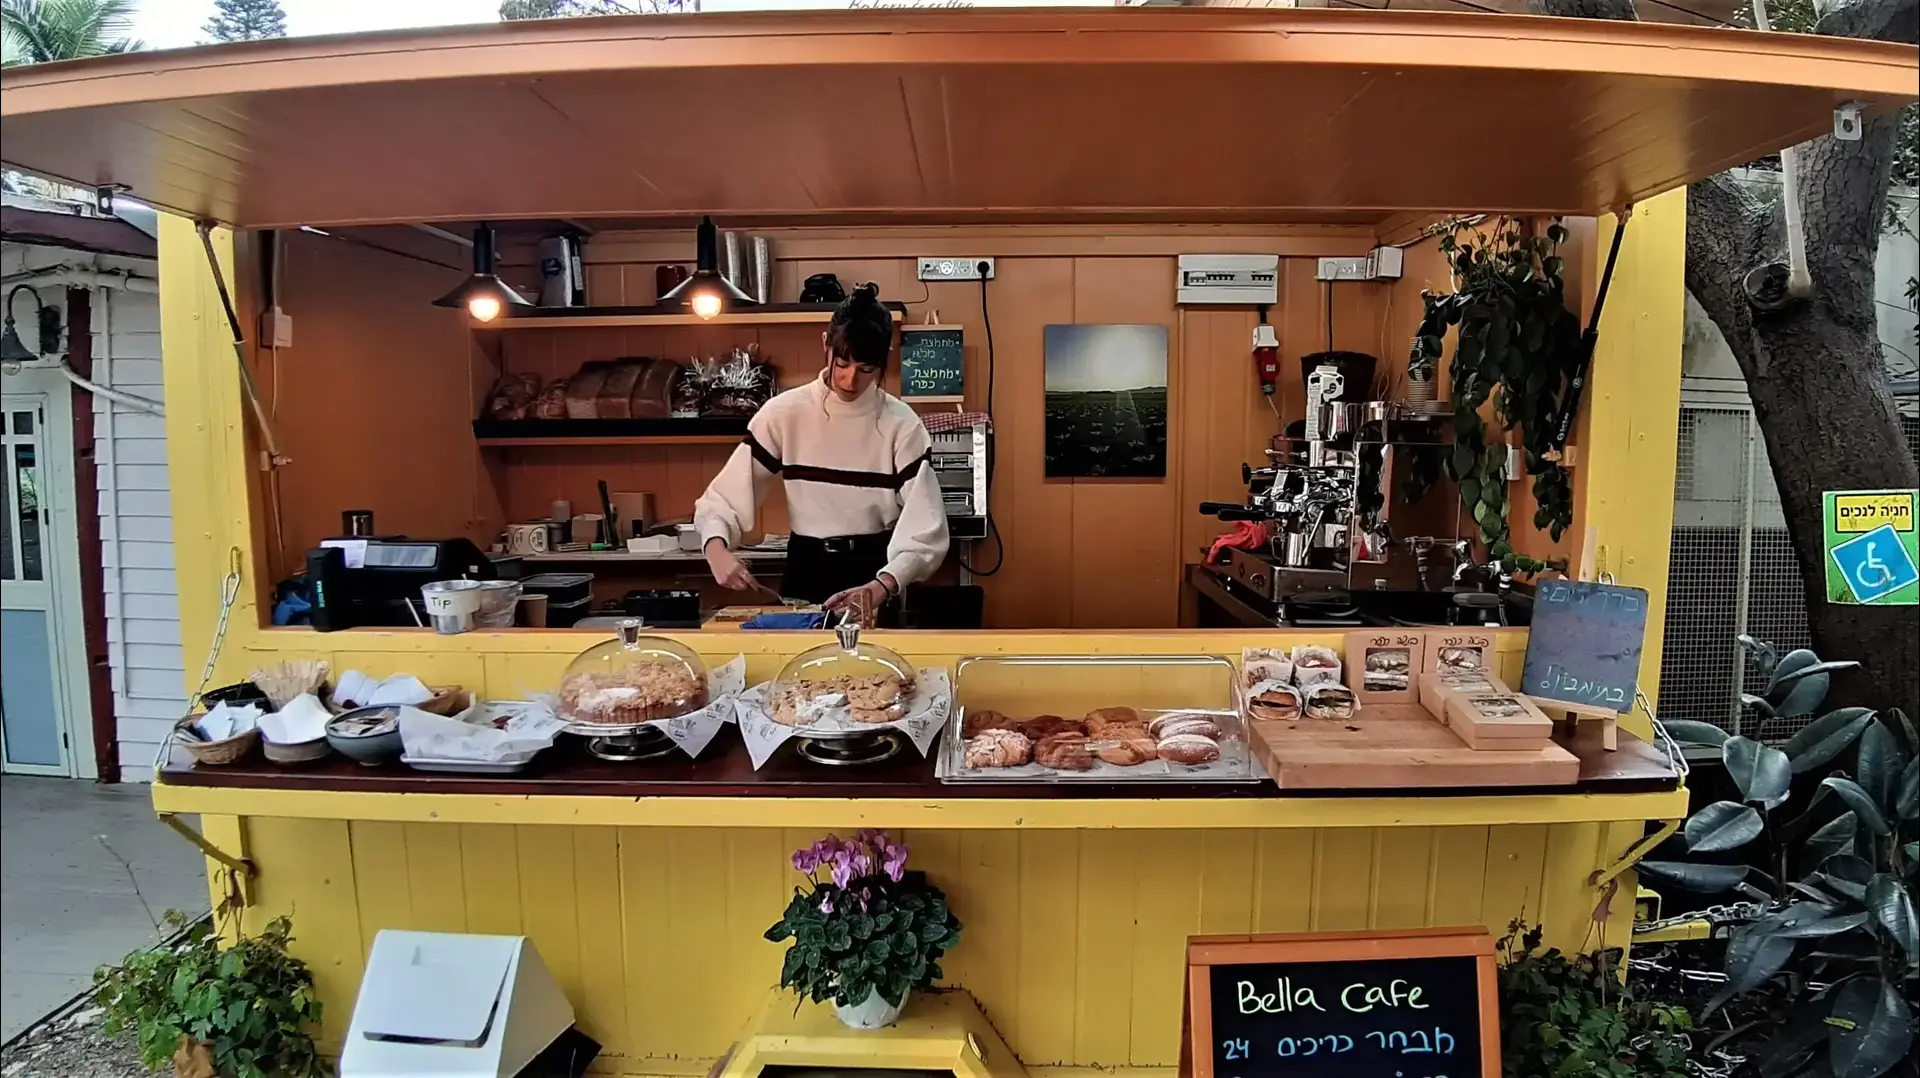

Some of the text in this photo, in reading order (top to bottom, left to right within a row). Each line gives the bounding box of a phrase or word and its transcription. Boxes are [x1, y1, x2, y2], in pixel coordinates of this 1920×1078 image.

[1840, 504, 1909, 517] חניה לנכים
[1236, 976, 1326, 1014] Bella
[1222, 1026, 1456, 1060] מבחר כריכים 24
